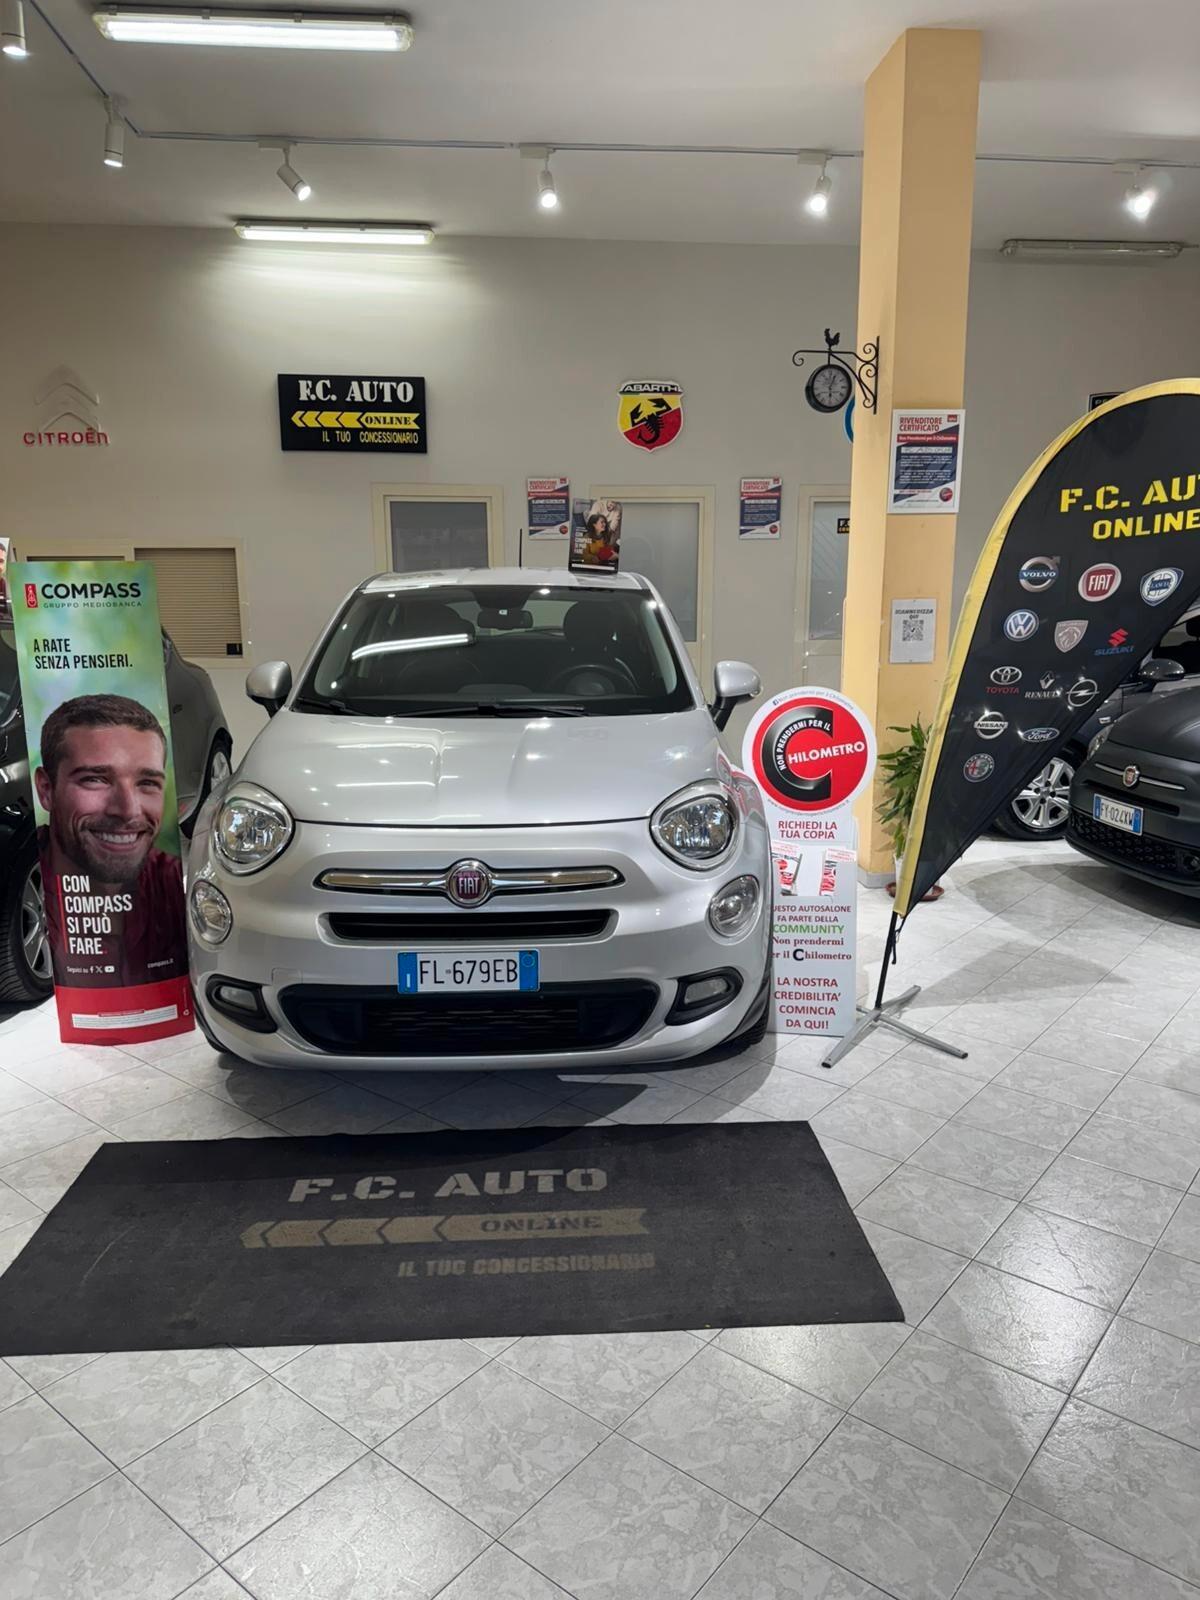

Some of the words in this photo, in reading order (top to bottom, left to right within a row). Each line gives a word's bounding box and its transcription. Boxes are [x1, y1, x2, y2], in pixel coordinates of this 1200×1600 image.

[298, 379, 337, 401] F.C.
[345, 381, 414, 403] AUTO
[624, 384, 678, 392] ABARTH
[365, 416, 411, 425] ONLINE
[322, 431, 330, 442] IL
[336, 431, 350, 442] TUO
[359, 431, 418, 444] CONCESSIONARIO
[1060, 485, 1130, 512] F.C.
[1142, 474, 1200, 505] AU
[1092, 508, 1200, 540] ONLINE
[1088, 574, 1113, 591] FIAT
[41, 583, 141, 599] COMPASS
[43, 601, 79, 609] GRUPPO
[33, 638, 41, 652] A
[43, 638, 71, 652] RATE
[35, 655, 70, 669] SENZA
[74, 654, 133, 669] PENSIERI.
[808, 720, 823, 728] PER
[824, 722, 831, 731] IL
[776, 720, 807, 753] PRENDERMI
[1027, 730, 1053, 740] Ford
[777, 753, 787, 771] NON
[778, 820, 822, 829] RICHIEDI
[825, 821, 838, 830] LA
[780, 830, 800, 838] TUA
[803, 830, 835, 839] COPIA
[62, 875, 90, 893] CON
[459, 877, 480, 894] FIAT
[64, 894, 133, 914] COMPASS
[67, 916, 80, 934] SI
[83, 913, 112, 934] PUÒ
[772, 924, 845, 934] COMMUNITY
[794, 937, 844, 947] prendermi
[792, 948, 852, 961] Chilometro
[777, 977, 790, 985] LA
[793, 978, 838, 987] NOSTRA
[779, 1005, 836, 1015] COMINCIA
[786, 1019, 801, 1027] DA
[804, 1020, 829, 1029] QUI!
[288, 1175, 415, 1202] F.C.
[434, 1168, 607, 1197] AUTO
[480, 1214, 602, 1232] ONLINE
[397, 1261, 418, 1278] IL
[473, 1253, 655, 1275] CONCESSIONARIO
